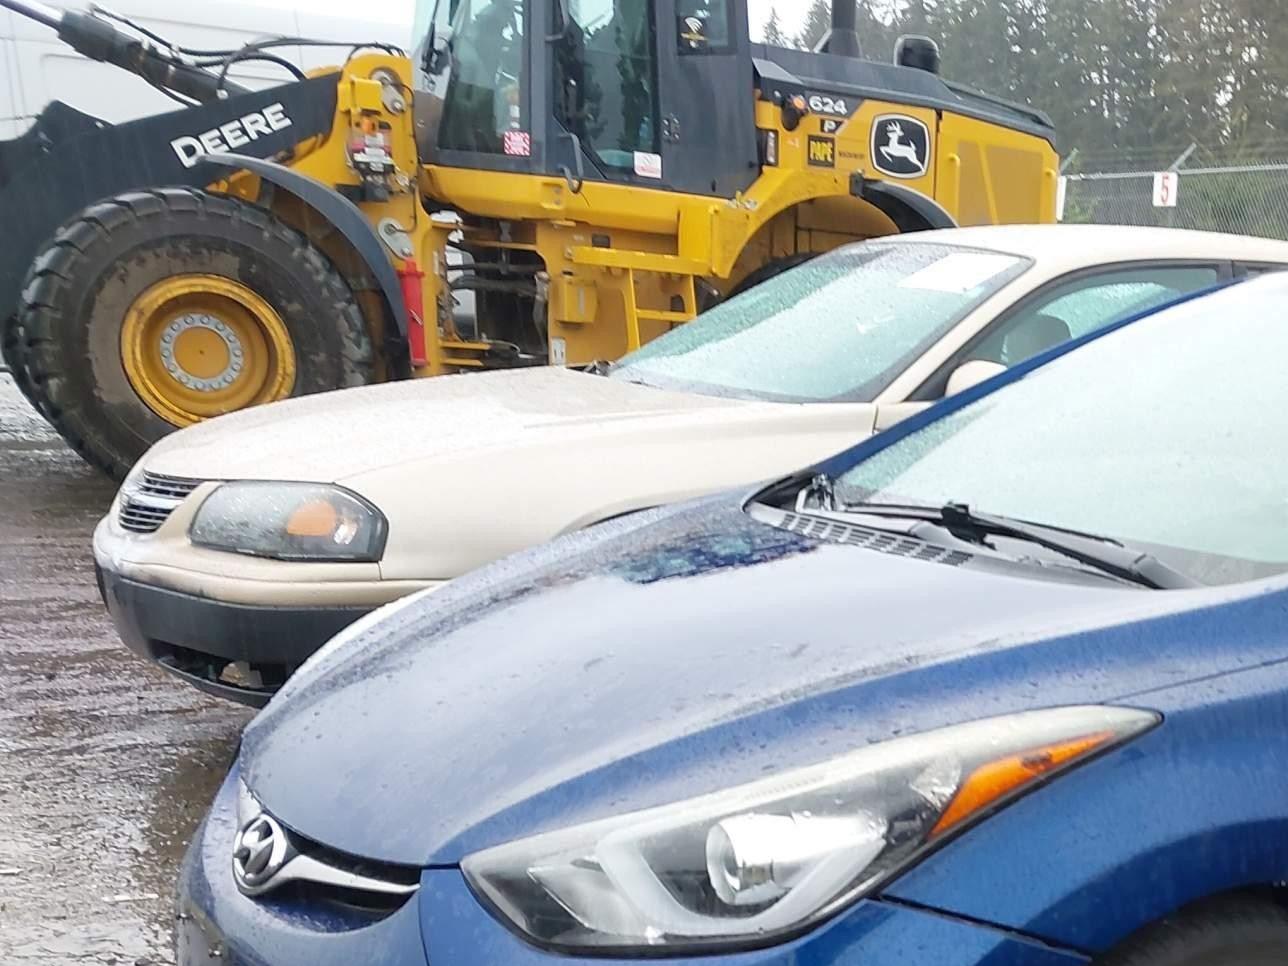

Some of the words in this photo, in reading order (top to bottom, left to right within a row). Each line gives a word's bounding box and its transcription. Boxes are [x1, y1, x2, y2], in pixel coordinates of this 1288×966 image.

[808, 95, 848, 116] 624
[170, 102, 293, 168] DEERE
[1160, 174, 1170, 205] 5
